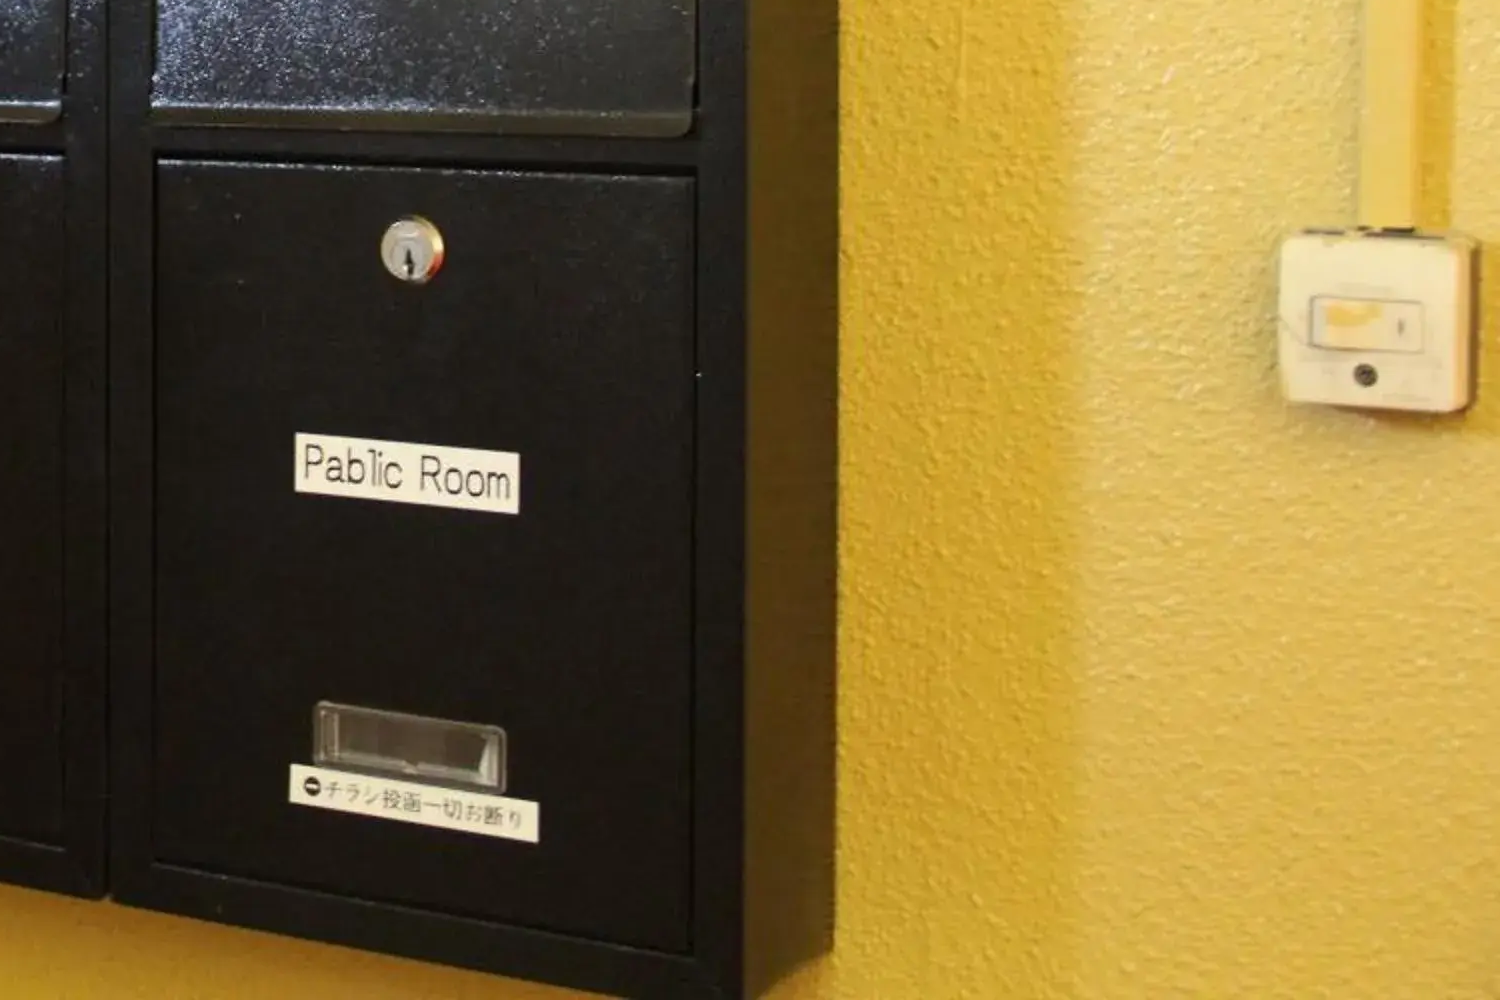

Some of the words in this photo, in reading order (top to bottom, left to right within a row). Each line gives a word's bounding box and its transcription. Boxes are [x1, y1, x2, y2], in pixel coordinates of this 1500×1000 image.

[304, 443, 404, 490] Pablic
[419, 454, 512, 500] Room
[324, 780, 523, 830] チラシ投函一切お断り
